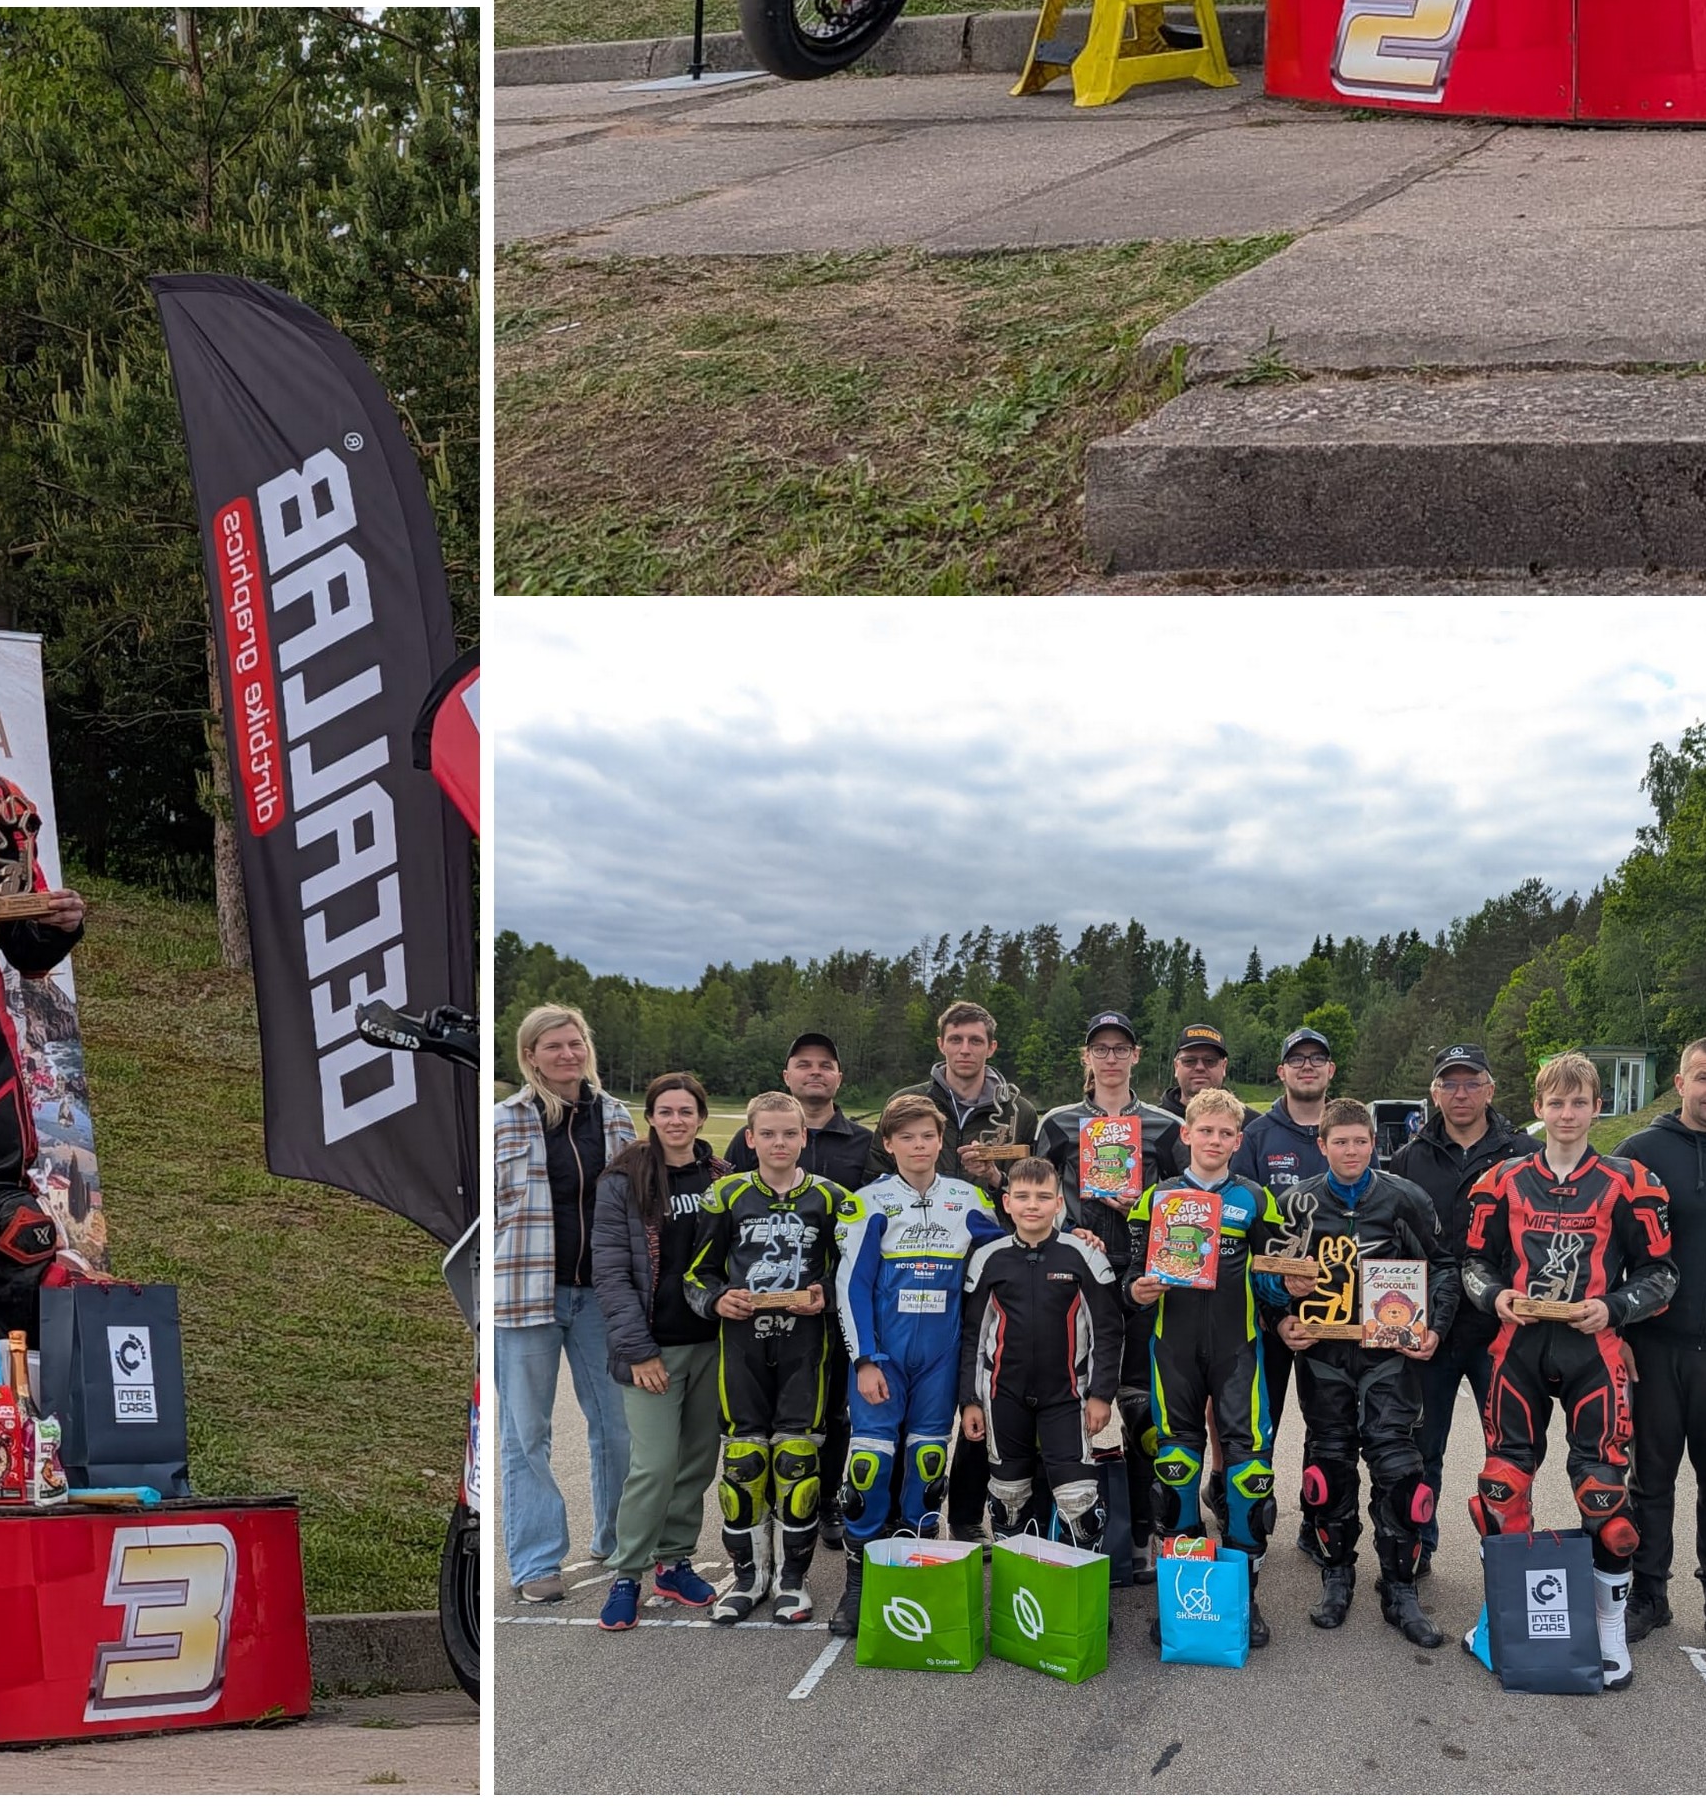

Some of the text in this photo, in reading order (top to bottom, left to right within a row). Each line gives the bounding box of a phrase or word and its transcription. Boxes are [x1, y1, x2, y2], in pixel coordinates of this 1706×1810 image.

[1092, 1132, 1131, 1147] LOOPS
[1166, 1211, 1210, 1226] LOOPS
[1558, 1216, 1595, 1229] RACING
[894, 1262, 954, 1271] MOTO TEAM
[1364, 1263, 1422, 1284] graci
[1372, 1281, 1416, 1291] CHOCOLATE
[117, 1388, 152, 1402] INTER
[117, 1400, 153, 1414] CARS
[82, 1523, 239, 1724] 3
[1531, 1613, 1566, 1623] INTER
[1531, 1623, 1567, 1633] CARS
[934, 1657, 961, 1667] Dobele
